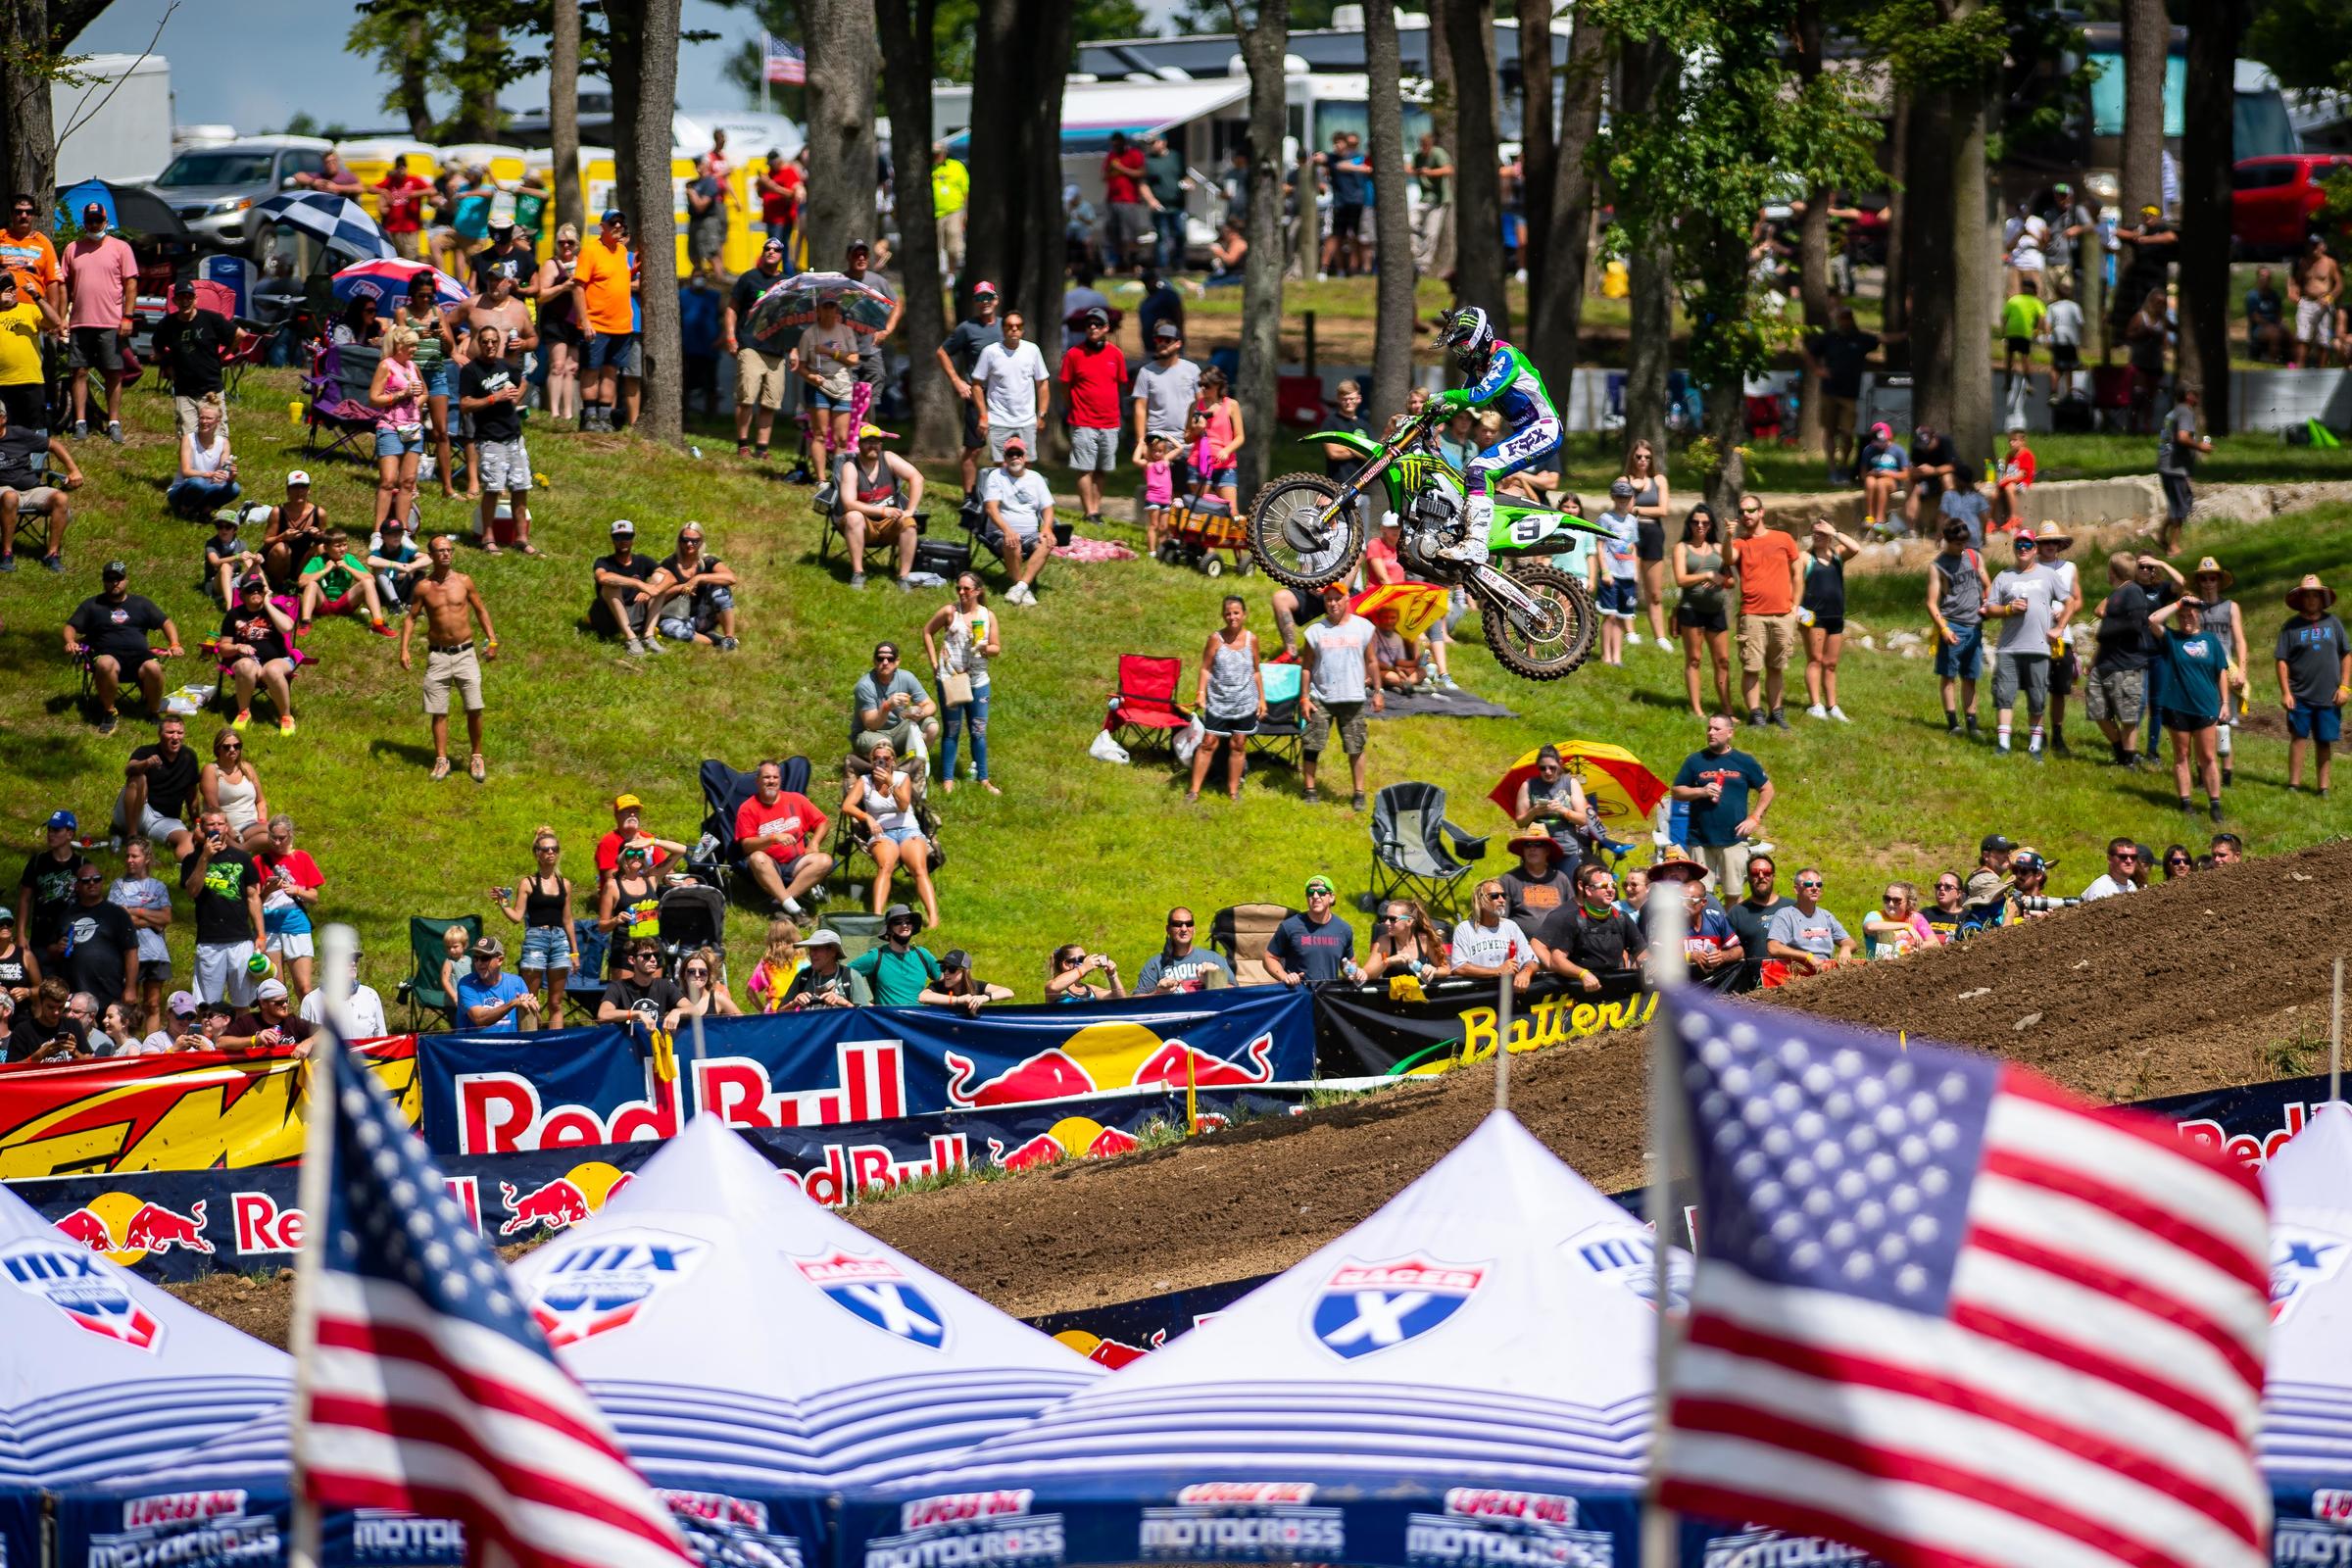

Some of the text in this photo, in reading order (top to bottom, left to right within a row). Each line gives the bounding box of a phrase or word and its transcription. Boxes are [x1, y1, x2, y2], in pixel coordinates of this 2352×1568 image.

[1505, 428, 1548, 457] FOX
[1517, 517, 1541, 541] 9
[1471, 939, 1511, 956] BUDWEIS
[455, 1040, 906, 1156] Red Bull
[848, 1132, 968, 1208] Bull
[230, 1192, 310, 1254] Re
[1336, 1267, 1473, 1288] RACER
[843, 1282, 945, 1339] X
[1322, 1290, 1433, 1346] X
[130, 1495, 199, 1527] LUCAS
[865, 1529, 1066, 1568] MOTOCROSS
[1140, 1519, 1346, 1545] MOTOCROSS
